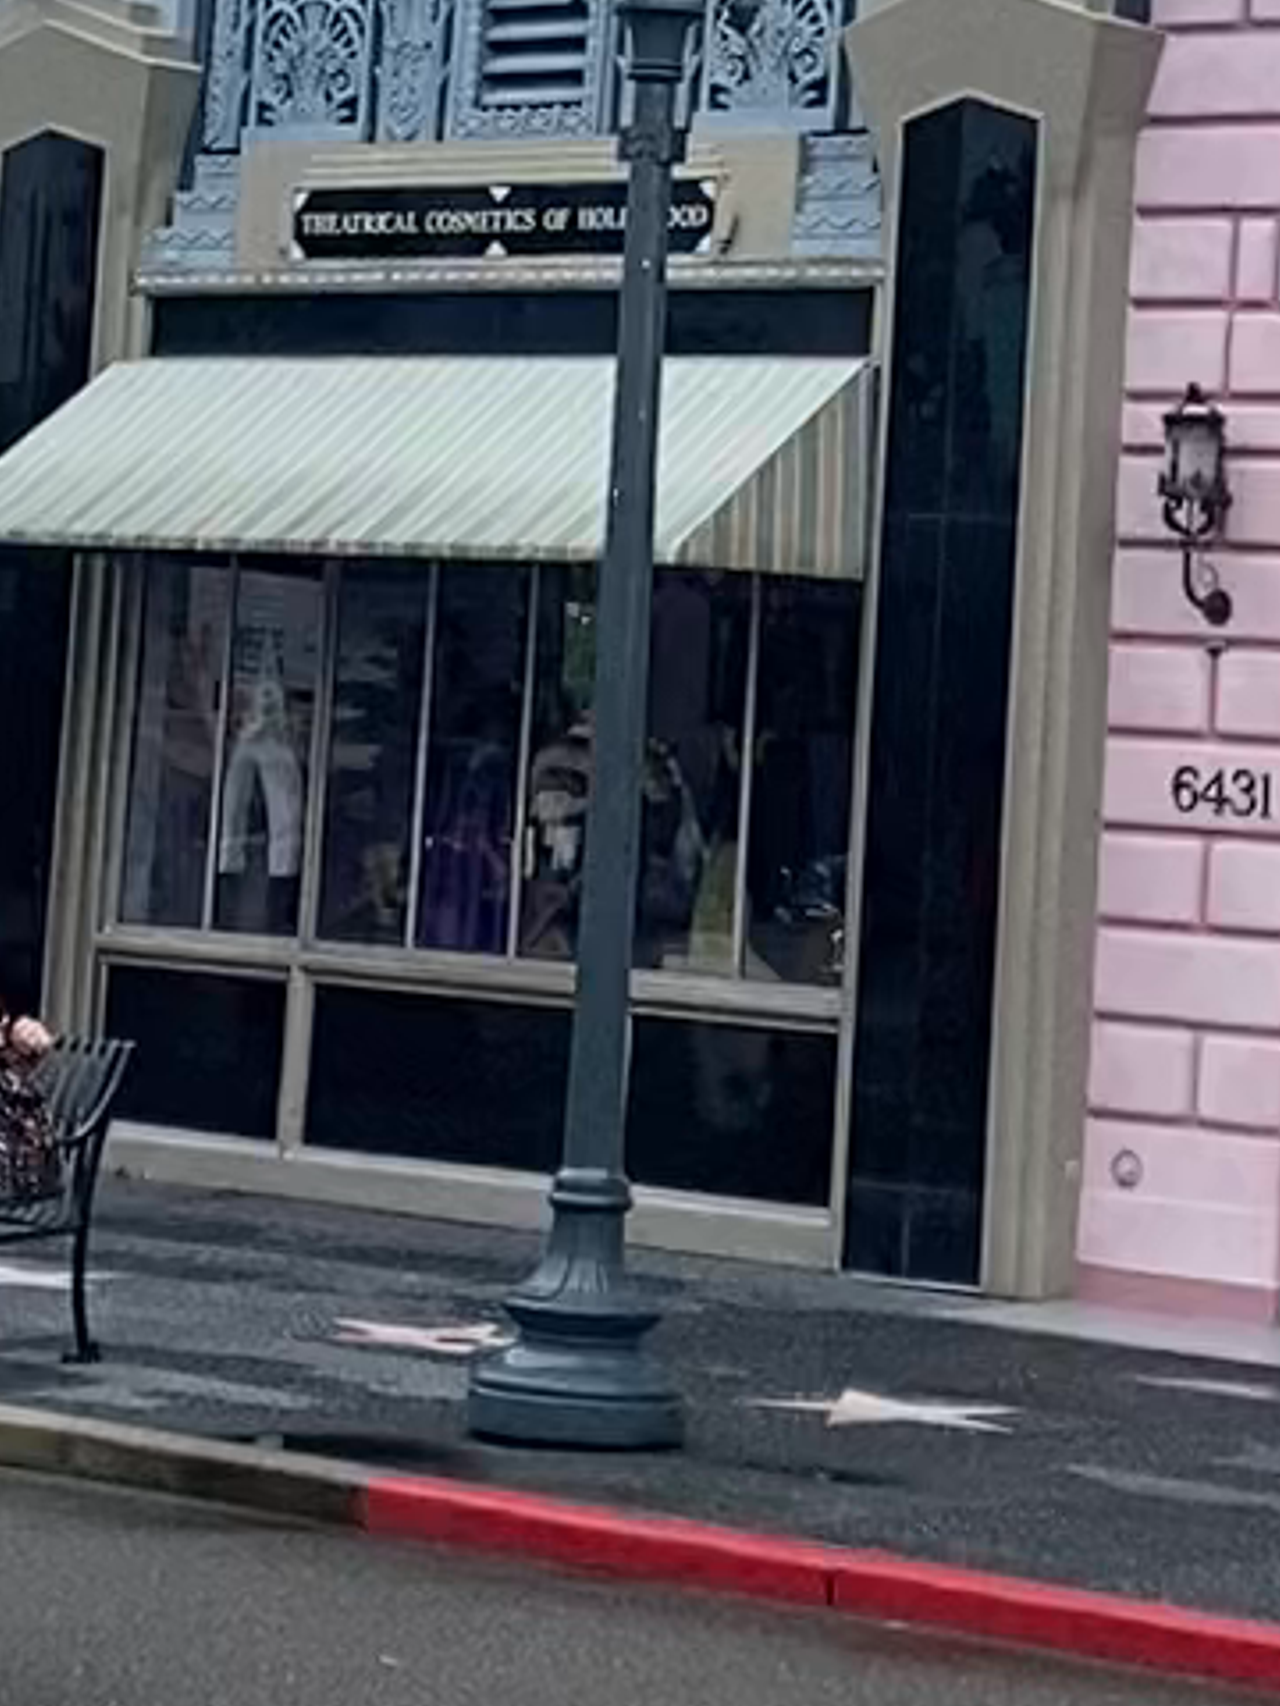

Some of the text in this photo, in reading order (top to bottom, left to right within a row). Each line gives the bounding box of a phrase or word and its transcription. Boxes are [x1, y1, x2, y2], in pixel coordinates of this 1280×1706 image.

[301, 210, 420, 235] THEATRICAL
[424, 206, 537, 234] COSMETICS
[541, 207, 570, 232] OF
[1171, 765, 1272, 820] 6431
